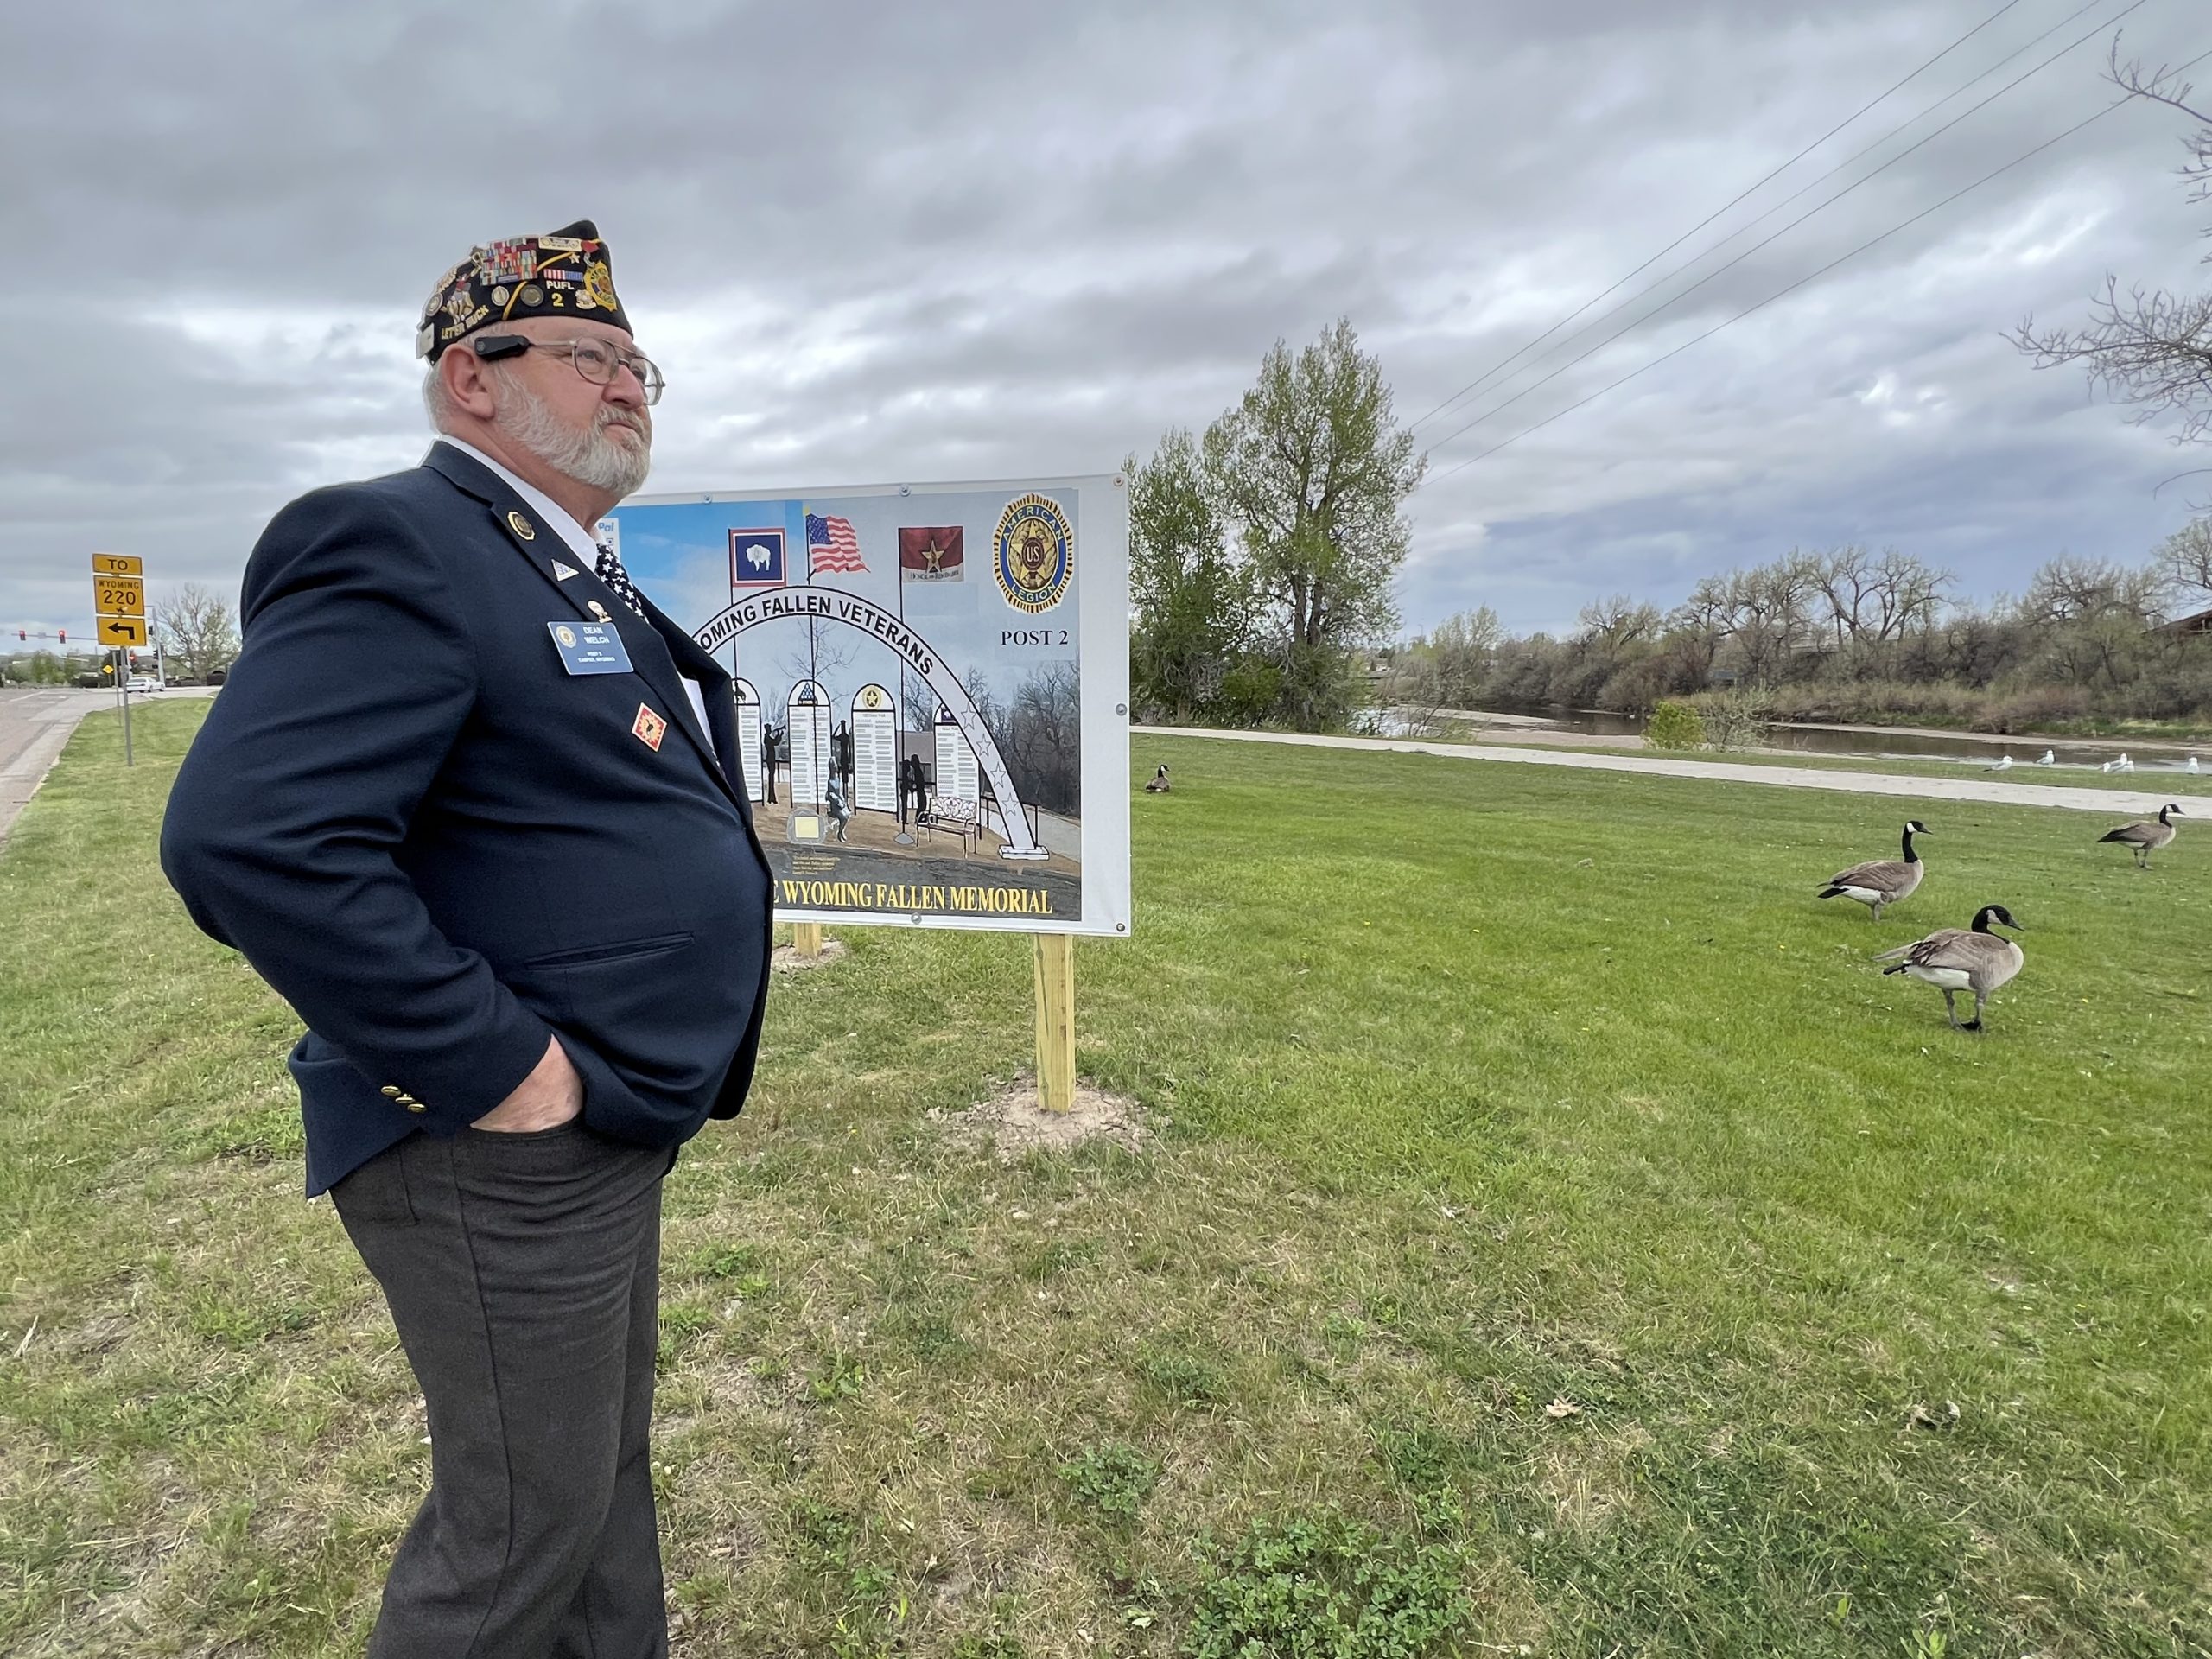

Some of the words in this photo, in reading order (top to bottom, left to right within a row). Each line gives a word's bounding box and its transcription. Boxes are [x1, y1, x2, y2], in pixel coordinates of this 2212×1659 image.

[546, 280, 575, 290] PUFL
[551, 292, 564, 308] 2
[1003, 506, 1064, 542] AMERICAN
[107, 559, 128, 570] TO
[98, 580, 139, 589] WYOMING
[104, 590, 136, 605] 220
[1011, 583, 1056, 602] LEGION
[583, 636, 610, 645] WELCH
[696, 606, 756, 651] OMING
[761, 595, 832, 617] FALLEN
[838, 599, 934, 676] VETERANS
[1001, 631, 1053, 645] POST
[1058, 630, 1069, 645] 2
[782, 880, 872, 907] WYOMING
[876, 883, 945, 910] FALLEN
[949, 886, 1052, 913] MEMORIAL
